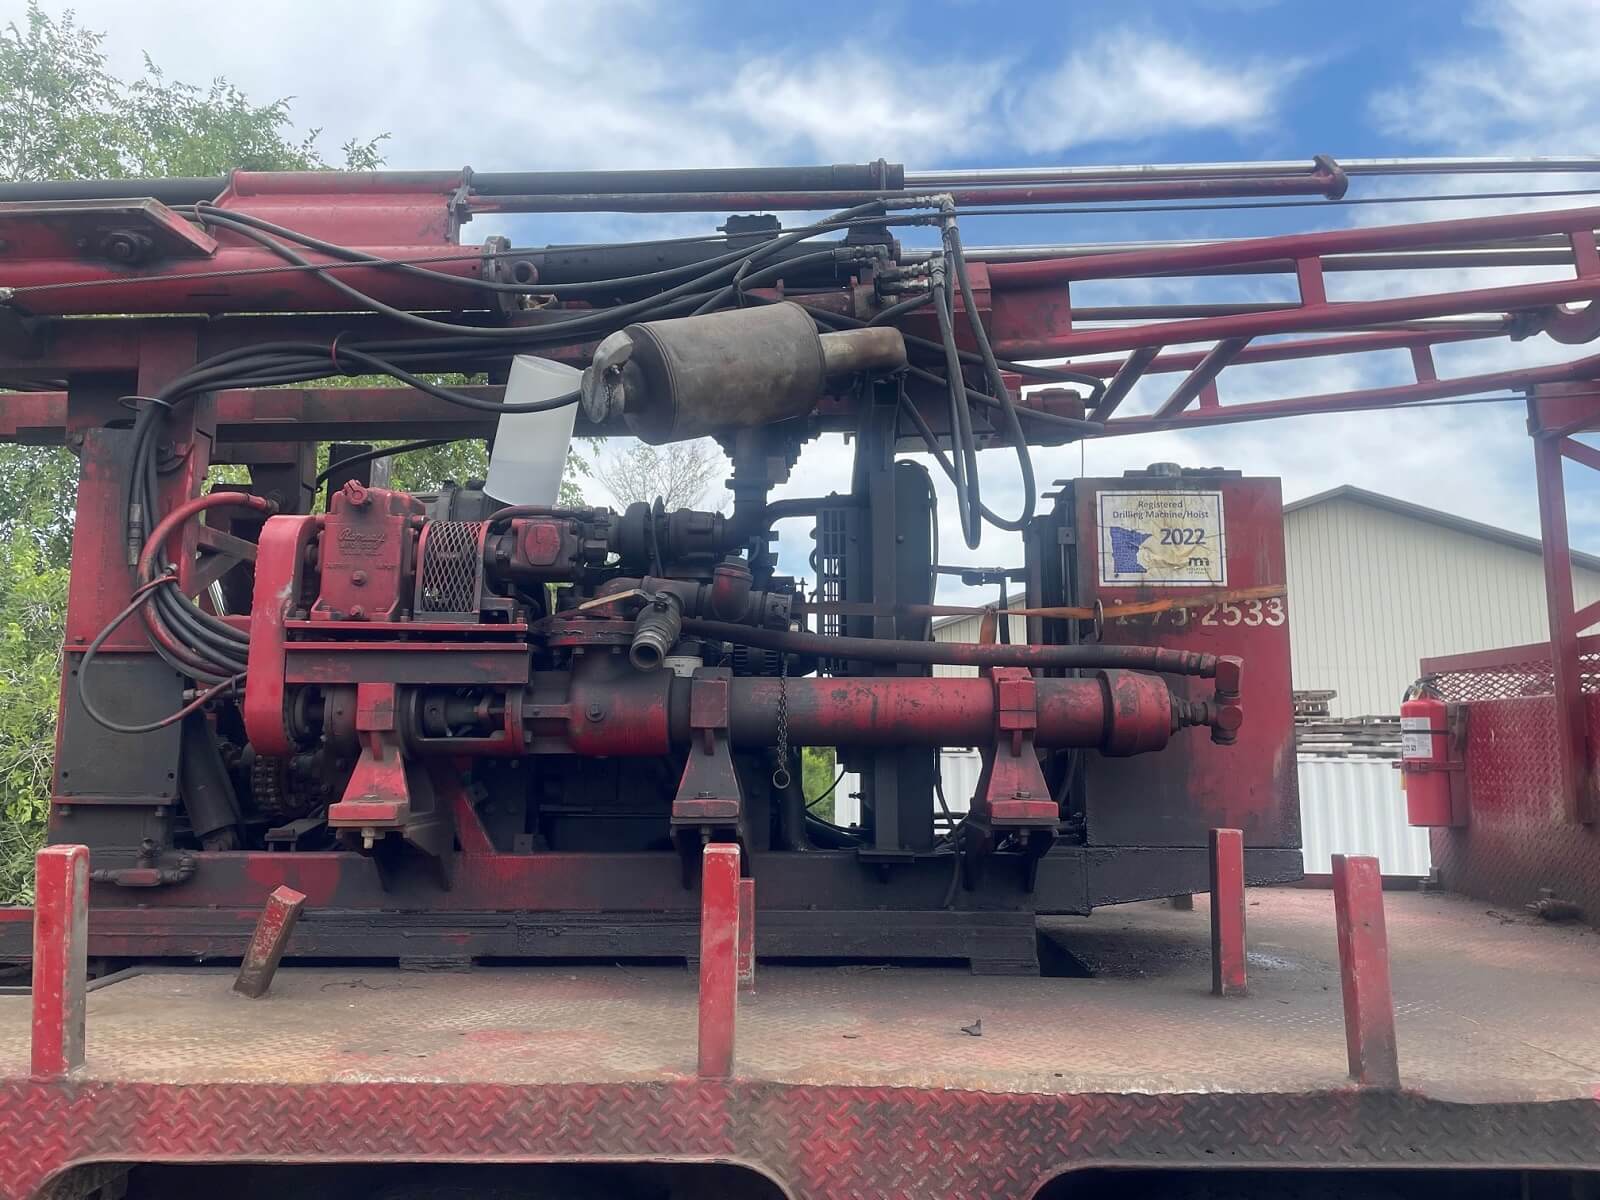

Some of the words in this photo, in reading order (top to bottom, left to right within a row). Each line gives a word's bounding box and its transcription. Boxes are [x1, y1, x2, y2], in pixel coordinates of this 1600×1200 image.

[1138, 501, 1184, 509] Registered
[1112, 511, 1143, 520] Drilling
[1145, 510, 1209, 520] Machine/Hoist
[1160, 528, 1206, 545] 2022
